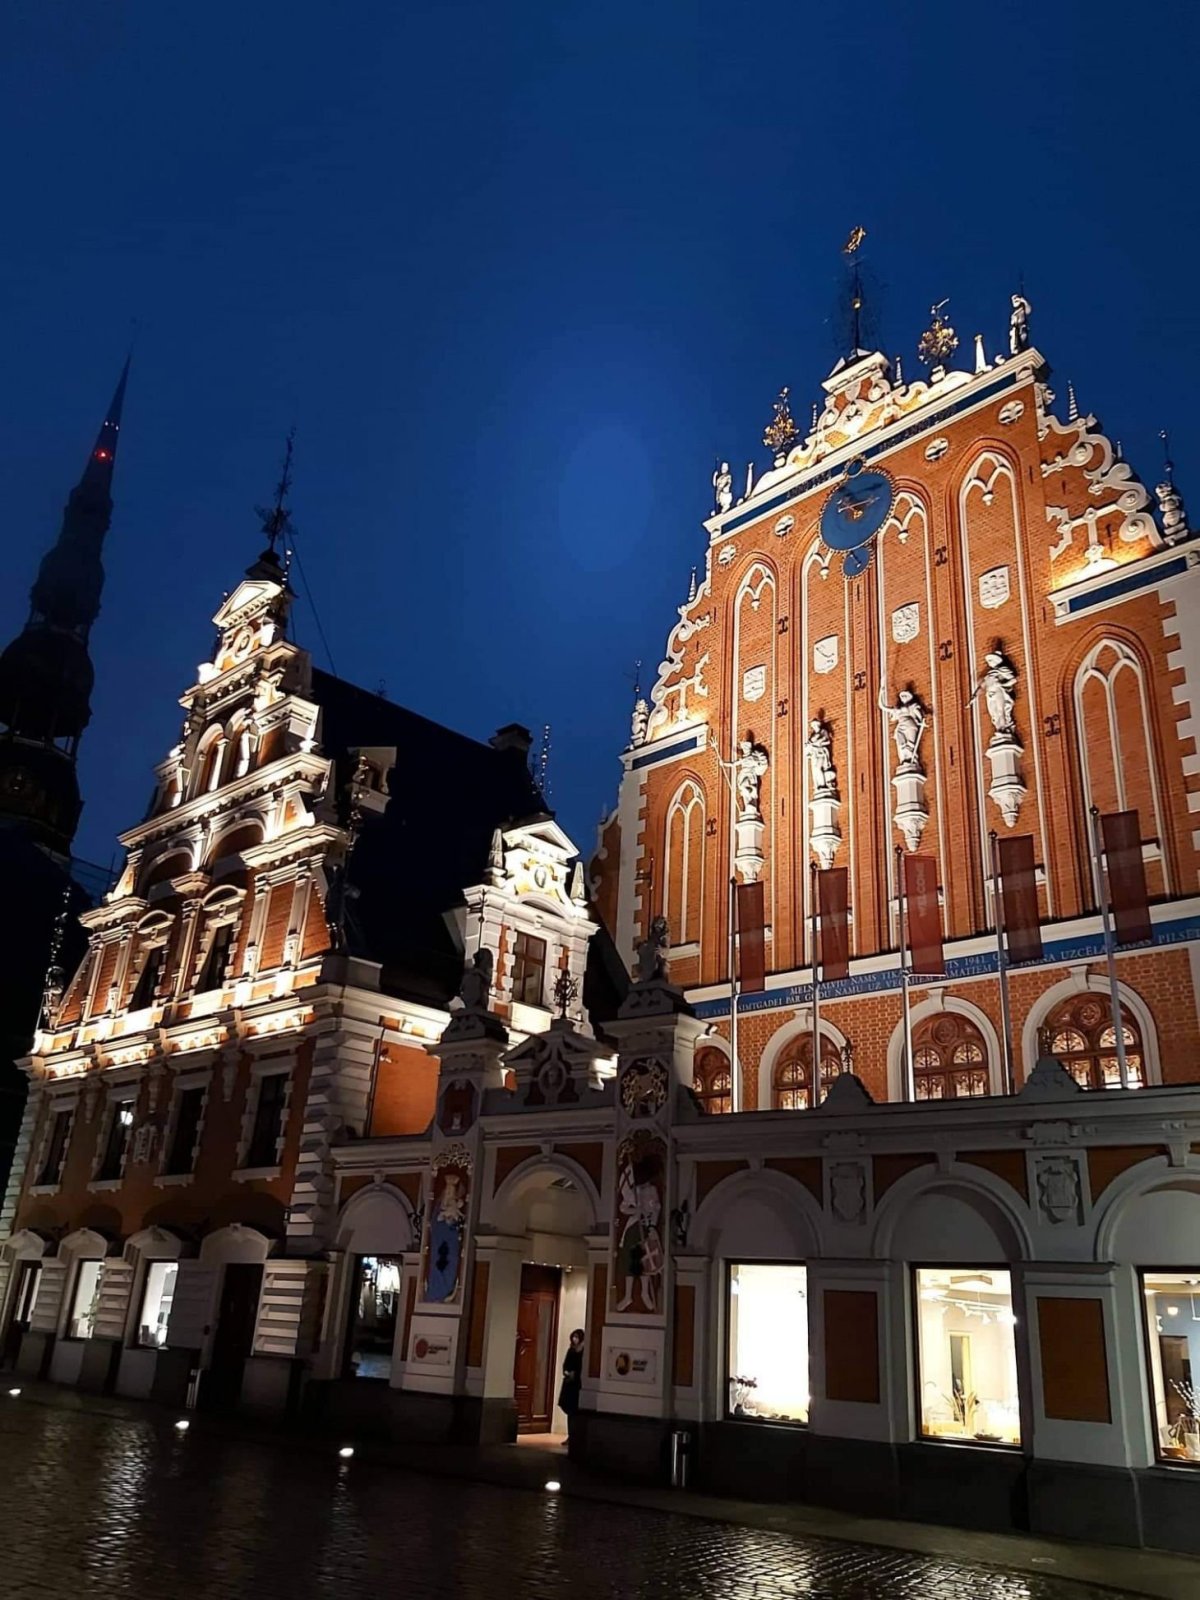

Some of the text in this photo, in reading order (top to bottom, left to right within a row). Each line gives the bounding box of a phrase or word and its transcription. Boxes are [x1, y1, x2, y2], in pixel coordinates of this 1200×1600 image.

[790, 980, 846, 995] MELNALVJU
[851, 974, 877, 985] NAMS
[786, 995, 801, 1005] PAR
[835, 985, 863, 996] NAMU
